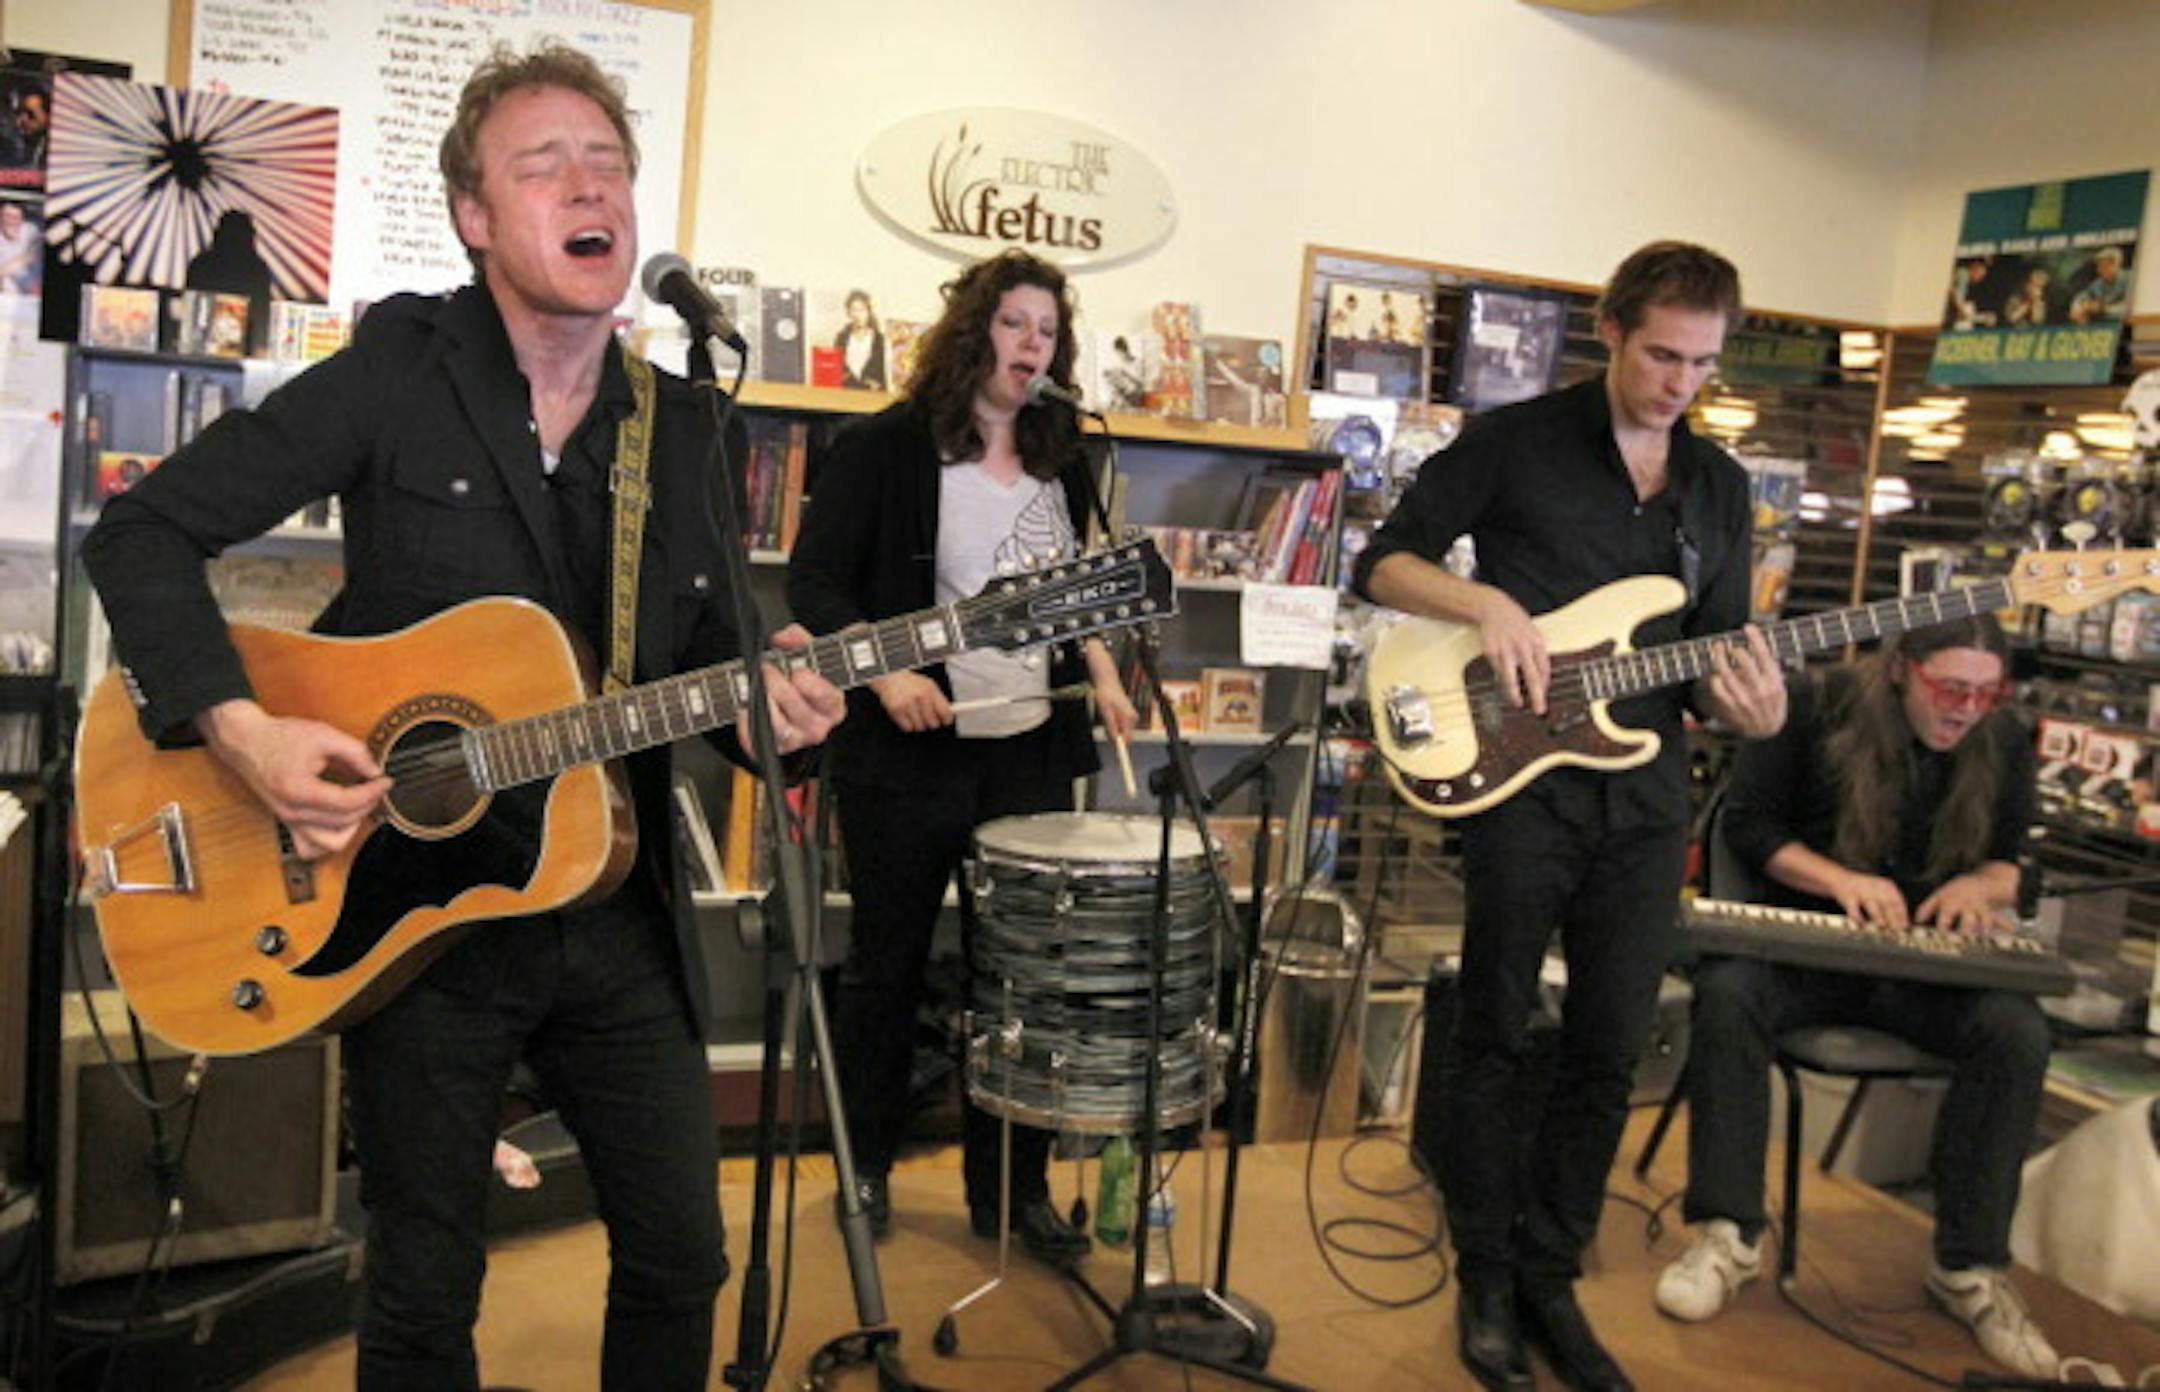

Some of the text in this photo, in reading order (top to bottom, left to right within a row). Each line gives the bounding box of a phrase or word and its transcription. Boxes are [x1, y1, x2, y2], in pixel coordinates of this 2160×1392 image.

[1071, 141, 1110, 174] THE
[1002, 157, 1108, 195] ELECTRIC
[977, 186, 1103, 251] fetus
[699, 268, 755, 286] FOUR
